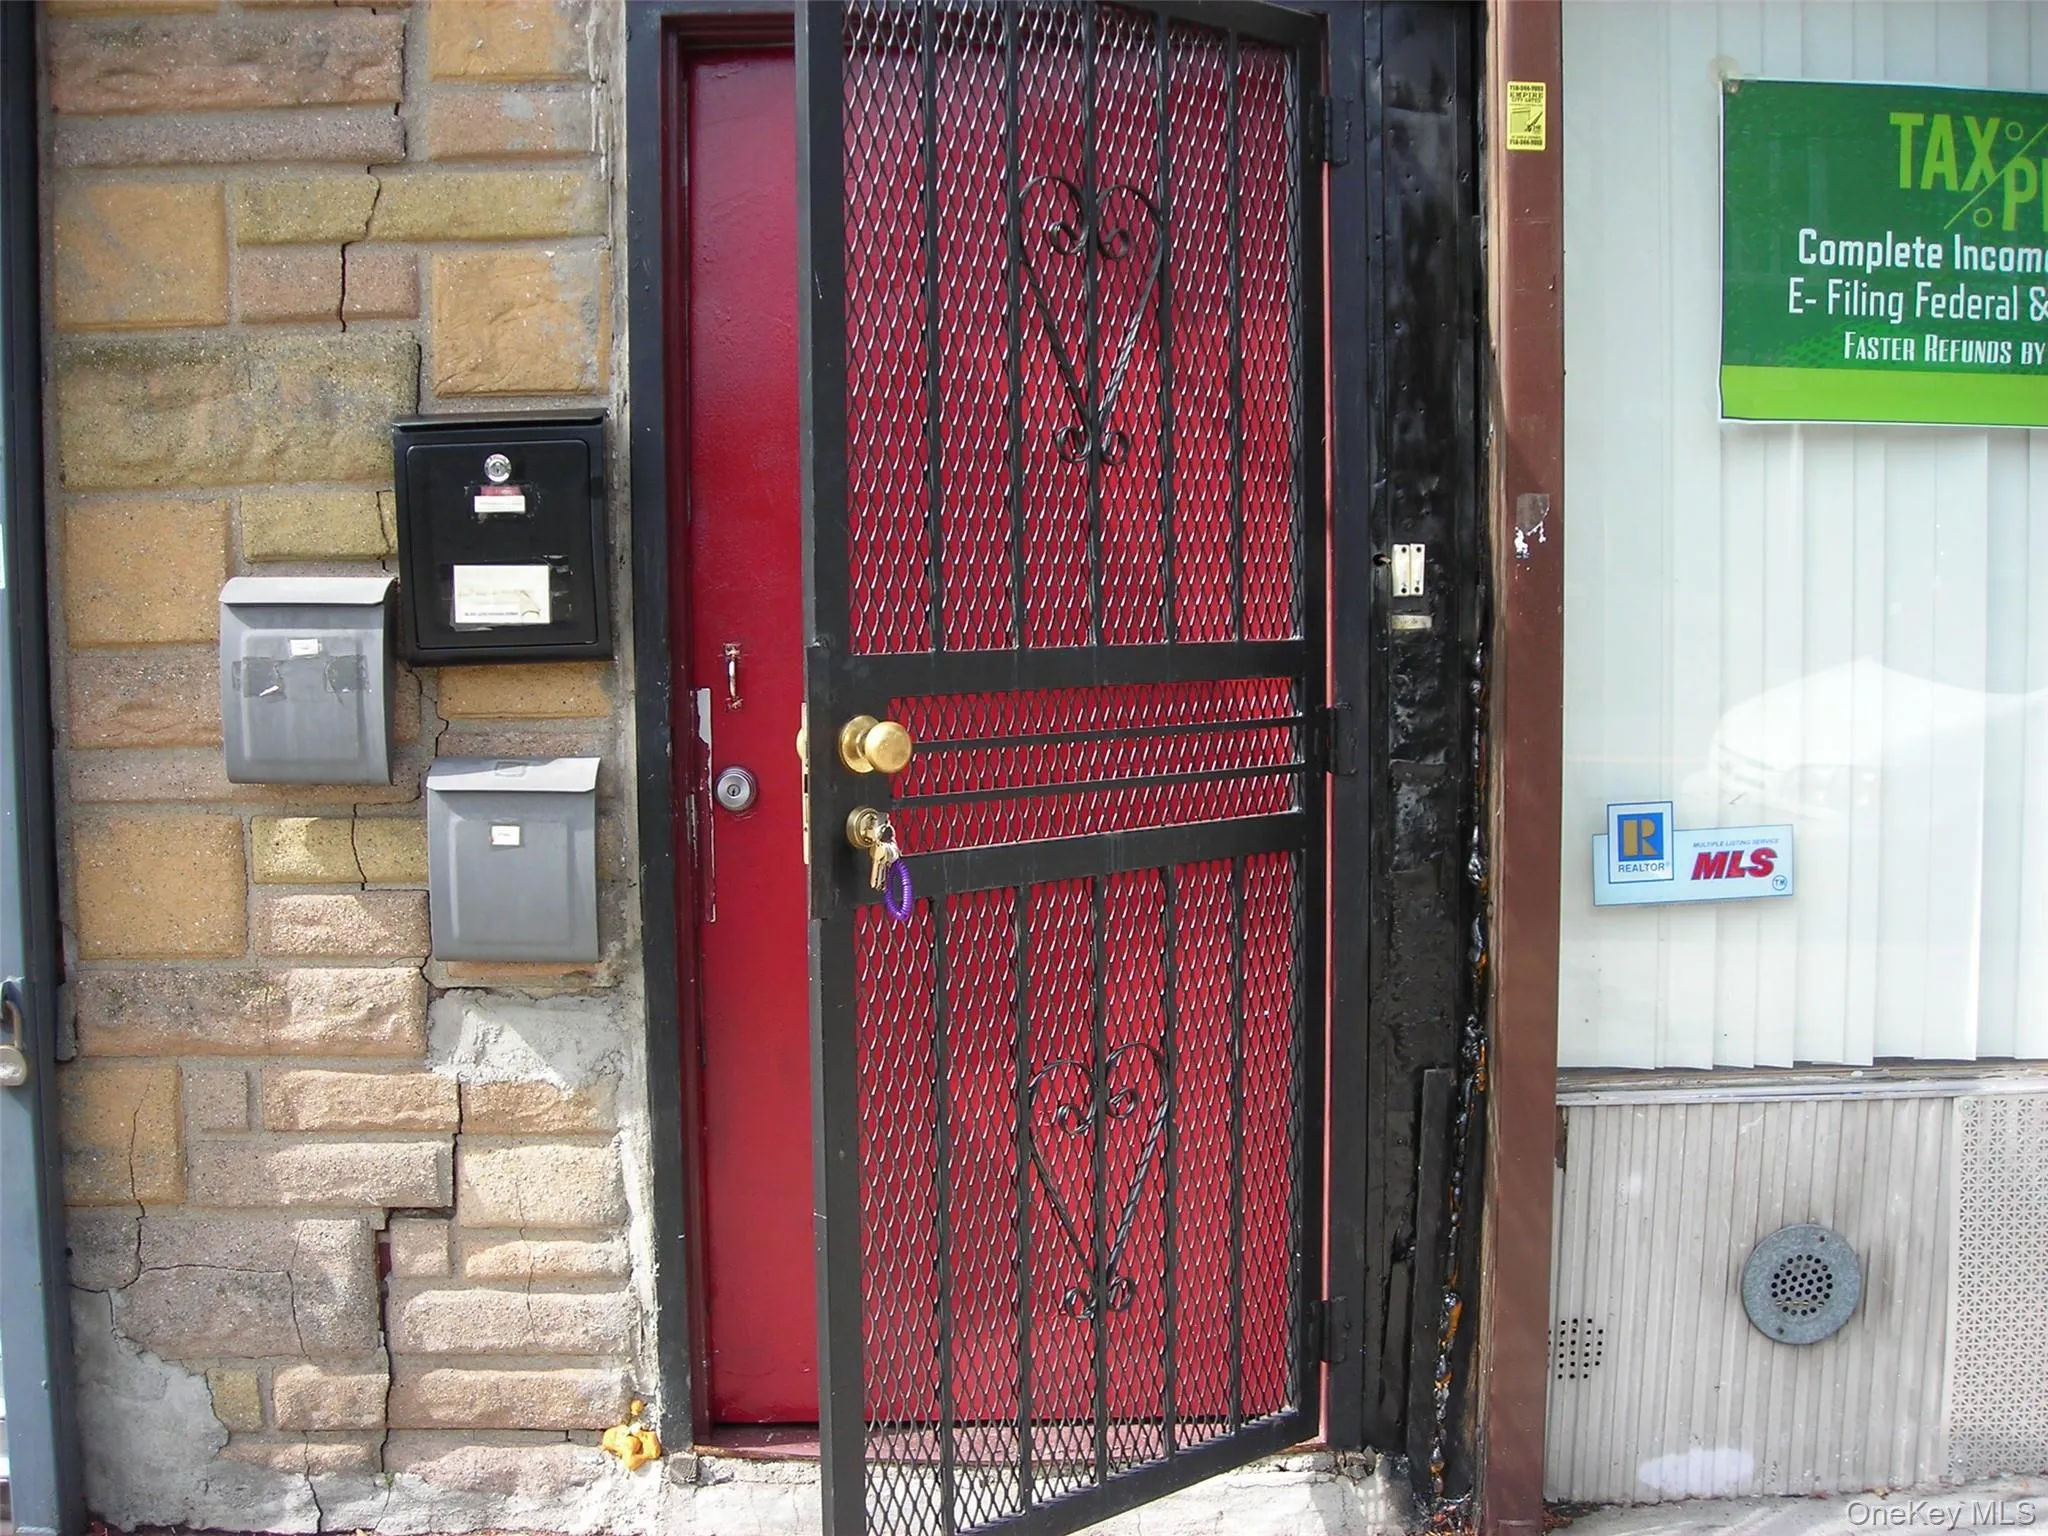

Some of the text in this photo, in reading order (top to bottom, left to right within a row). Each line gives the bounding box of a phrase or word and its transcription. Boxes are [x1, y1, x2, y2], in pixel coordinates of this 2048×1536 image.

[1889, 112, 2001, 191] TAX
[1799, 228, 1943, 274] Complete
[1827, 279, 1904, 324] Filing
[1915, 281, 2019, 321] Federal
[2030, 287, 2048, 321] &
[1844, 331, 2046, 365] FASTER REFUNDS BY
[1691, 847, 1778, 880] MLS
